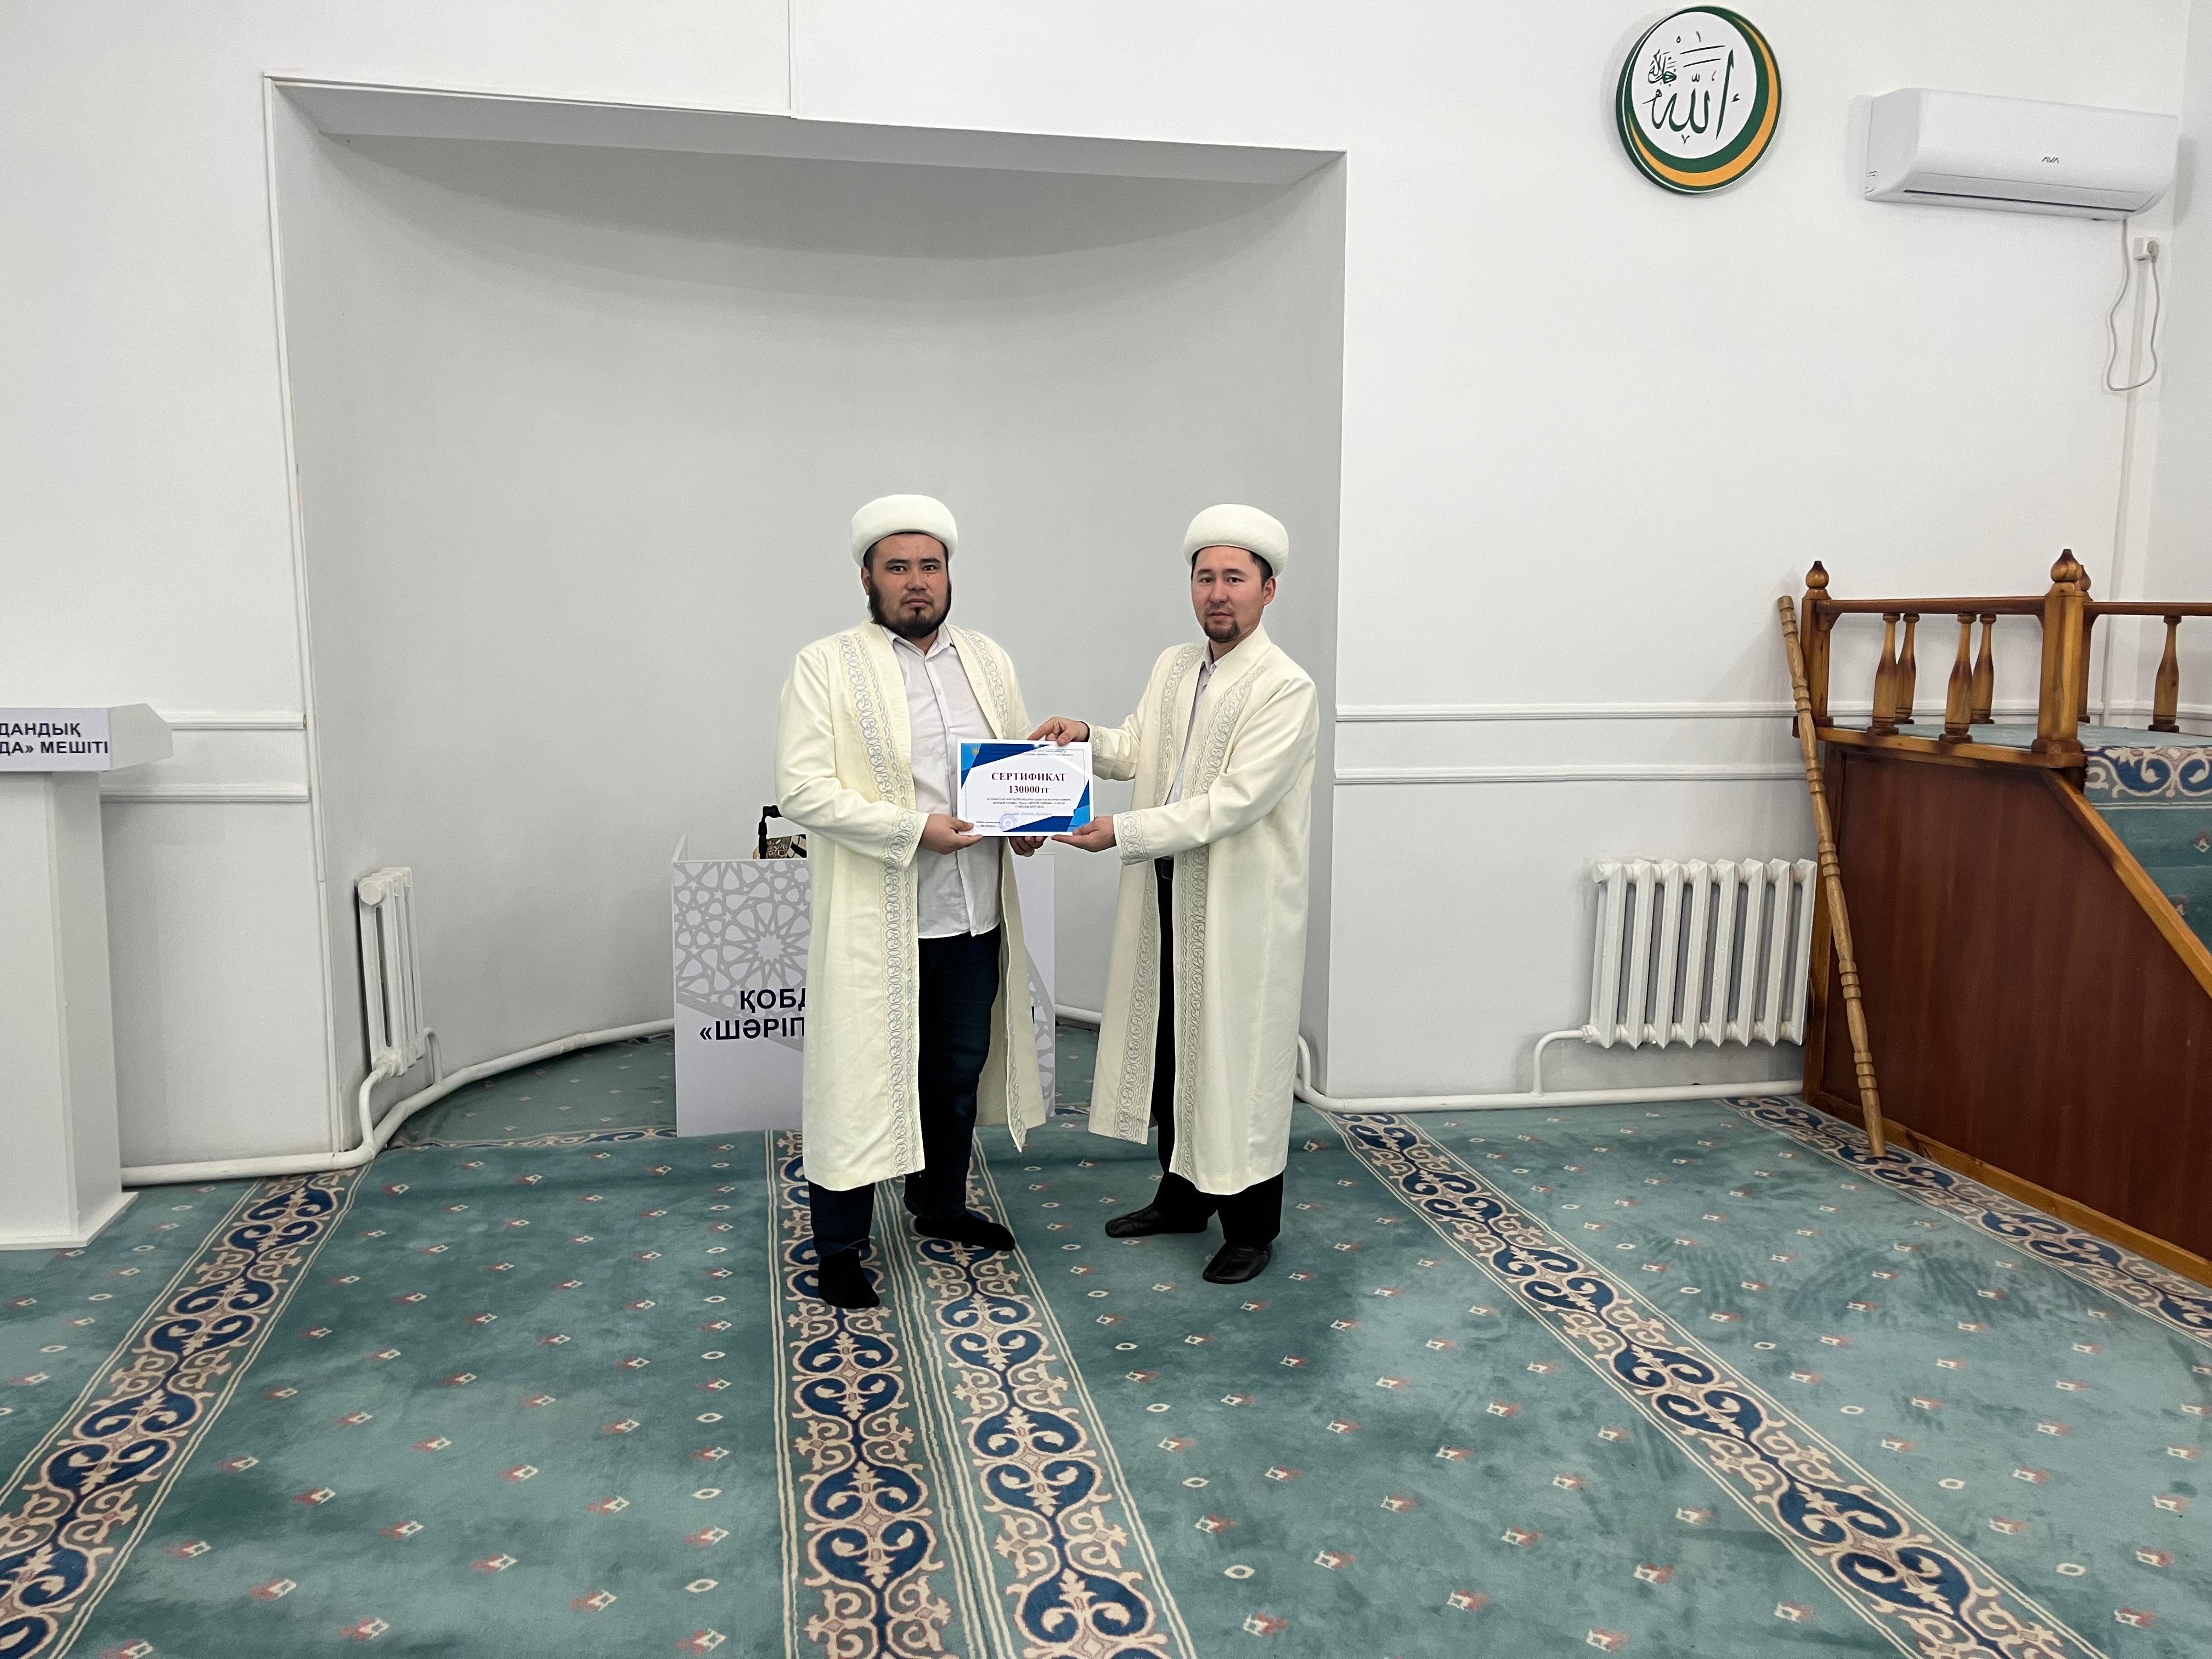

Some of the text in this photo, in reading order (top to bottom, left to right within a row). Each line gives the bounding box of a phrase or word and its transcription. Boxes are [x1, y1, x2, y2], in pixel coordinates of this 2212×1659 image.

[0, 723, 81, 737] ДАНДЫҚ
[41, 741, 109, 753] МЕШІТІ
[991, 772, 1066, 781] СЕРТИФИКАТ
